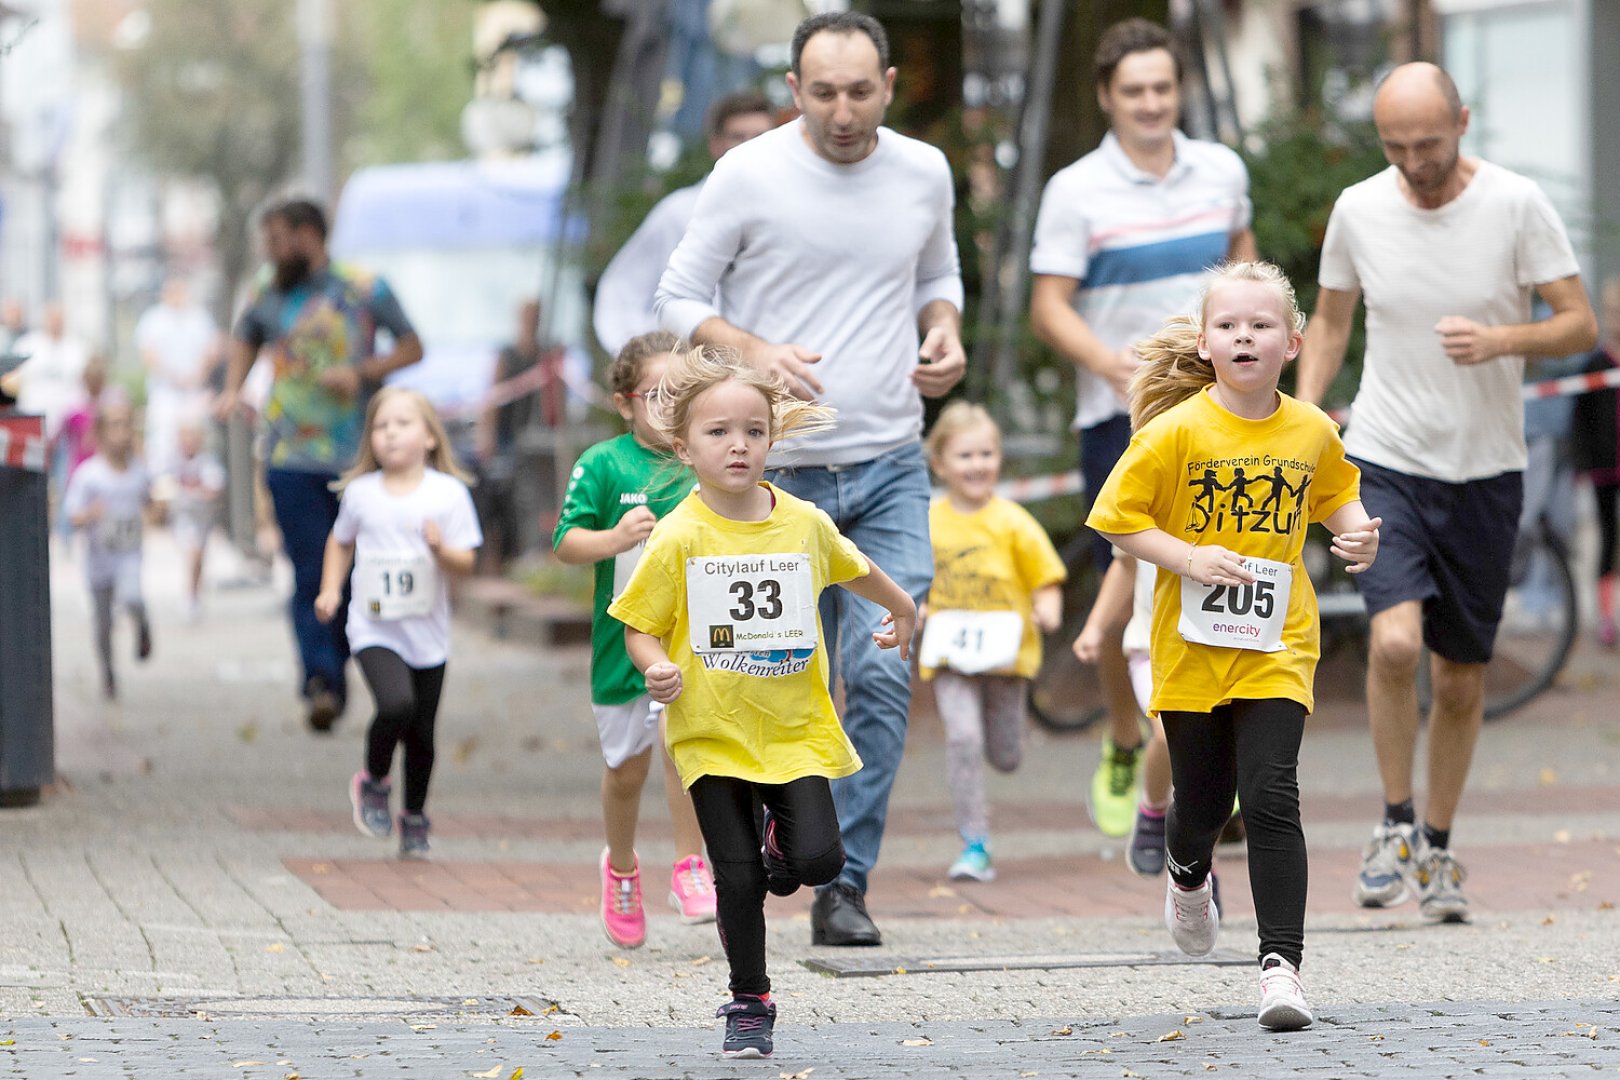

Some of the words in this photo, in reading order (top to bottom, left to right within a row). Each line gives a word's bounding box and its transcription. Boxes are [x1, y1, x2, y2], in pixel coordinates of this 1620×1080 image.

[1187, 456, 1260, 476] Förderverein
[1263, 454, 1316, 474] Grundschule
[620, 492, 648, 505] JAKO
[704, 560, 766, 578] Citylauf
[769, 559, 799, 573] Leer
[1255, 563, 1279, 577] Leer
[382, 570, 414, 596] 19
[728, 579, 783, 621] 33
[1201, 579, 1275, 619] 205
[784, 629, 804, 639] LEER
[952, 628, 984, 652] 41
[1213, 622, 1261, 638] enercity
[702, 651, 809, 677] Wolkenreiter
